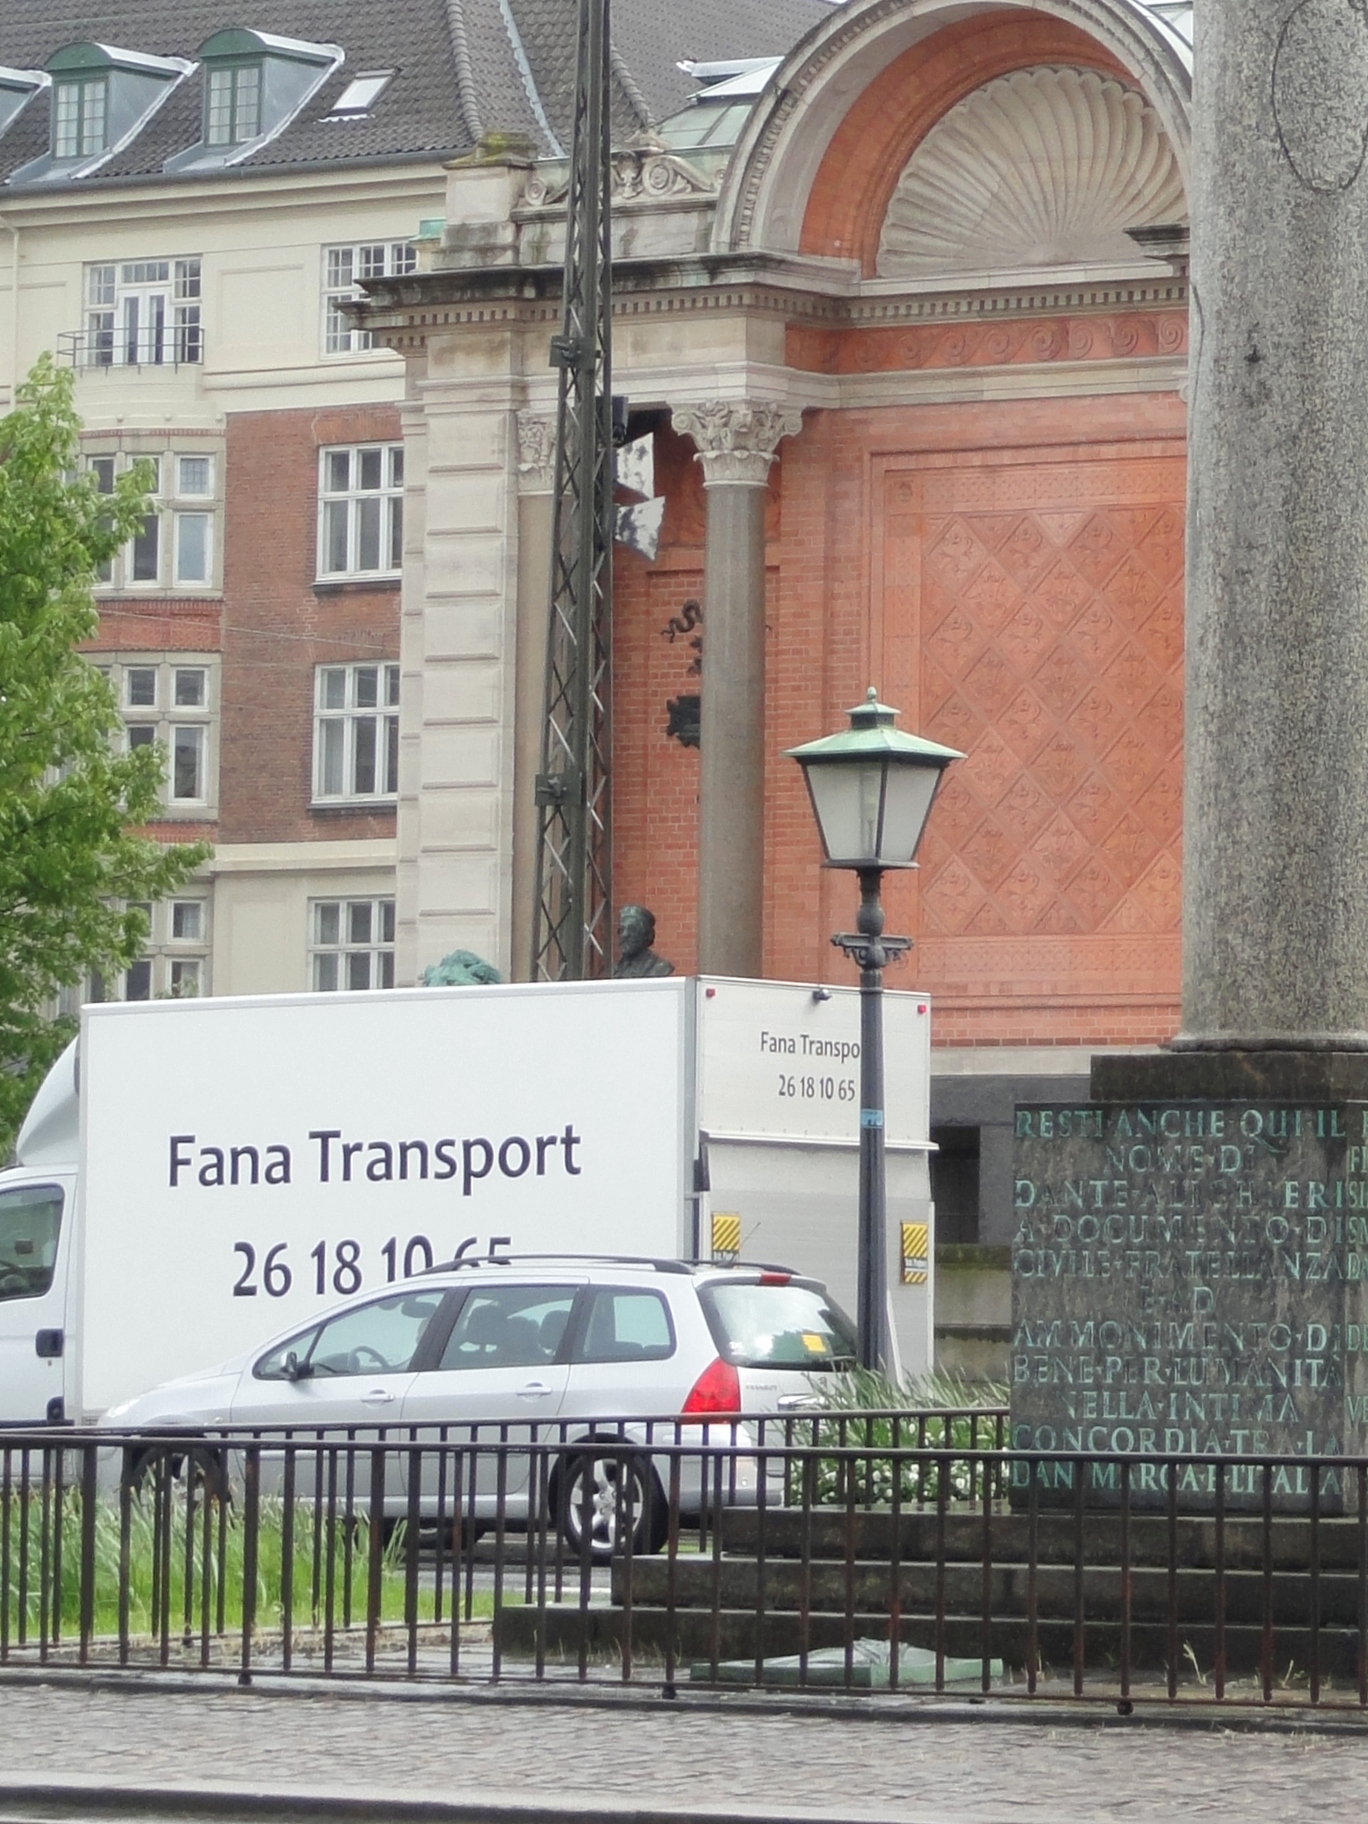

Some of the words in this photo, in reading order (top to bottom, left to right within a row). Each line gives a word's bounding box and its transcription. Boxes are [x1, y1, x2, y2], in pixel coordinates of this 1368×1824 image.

[761, 1032, 796, 1054] Fana
[800, 1034, 860, 1064] Transpo
[779, 1074, 796, 1097] 26
[800, 1076, 815, 1099] 18
[820, 1077, 834, 1100] 10
[838, 1079, 855, 1102] 65
[1014, 1110, 1104, 1138] RESTI
[1112, 1108, 1225, 1138] ANCHE
[1240, 1109, 1304, 1154] QUI
[1315, 1110, 1346, 1138] IL
[168, 1135, 292, 1188] Fana
[309, 1123, 582, 1196] Transport
[1014, 1180, 1128, 1209] DANTE
[1306, 1215, 1342, 1244] DI
[232, 1241, 293, 1297] 26
[310, 1238, 363, 1295] 18
[381, 1235, 433, 1283] 10
[1013, 1354, 1095, 1384] BENE
[1011, 1425, 1222, 1455] CONCORDIA
[1011, 1460, 1201, 1491] DANMARCA
